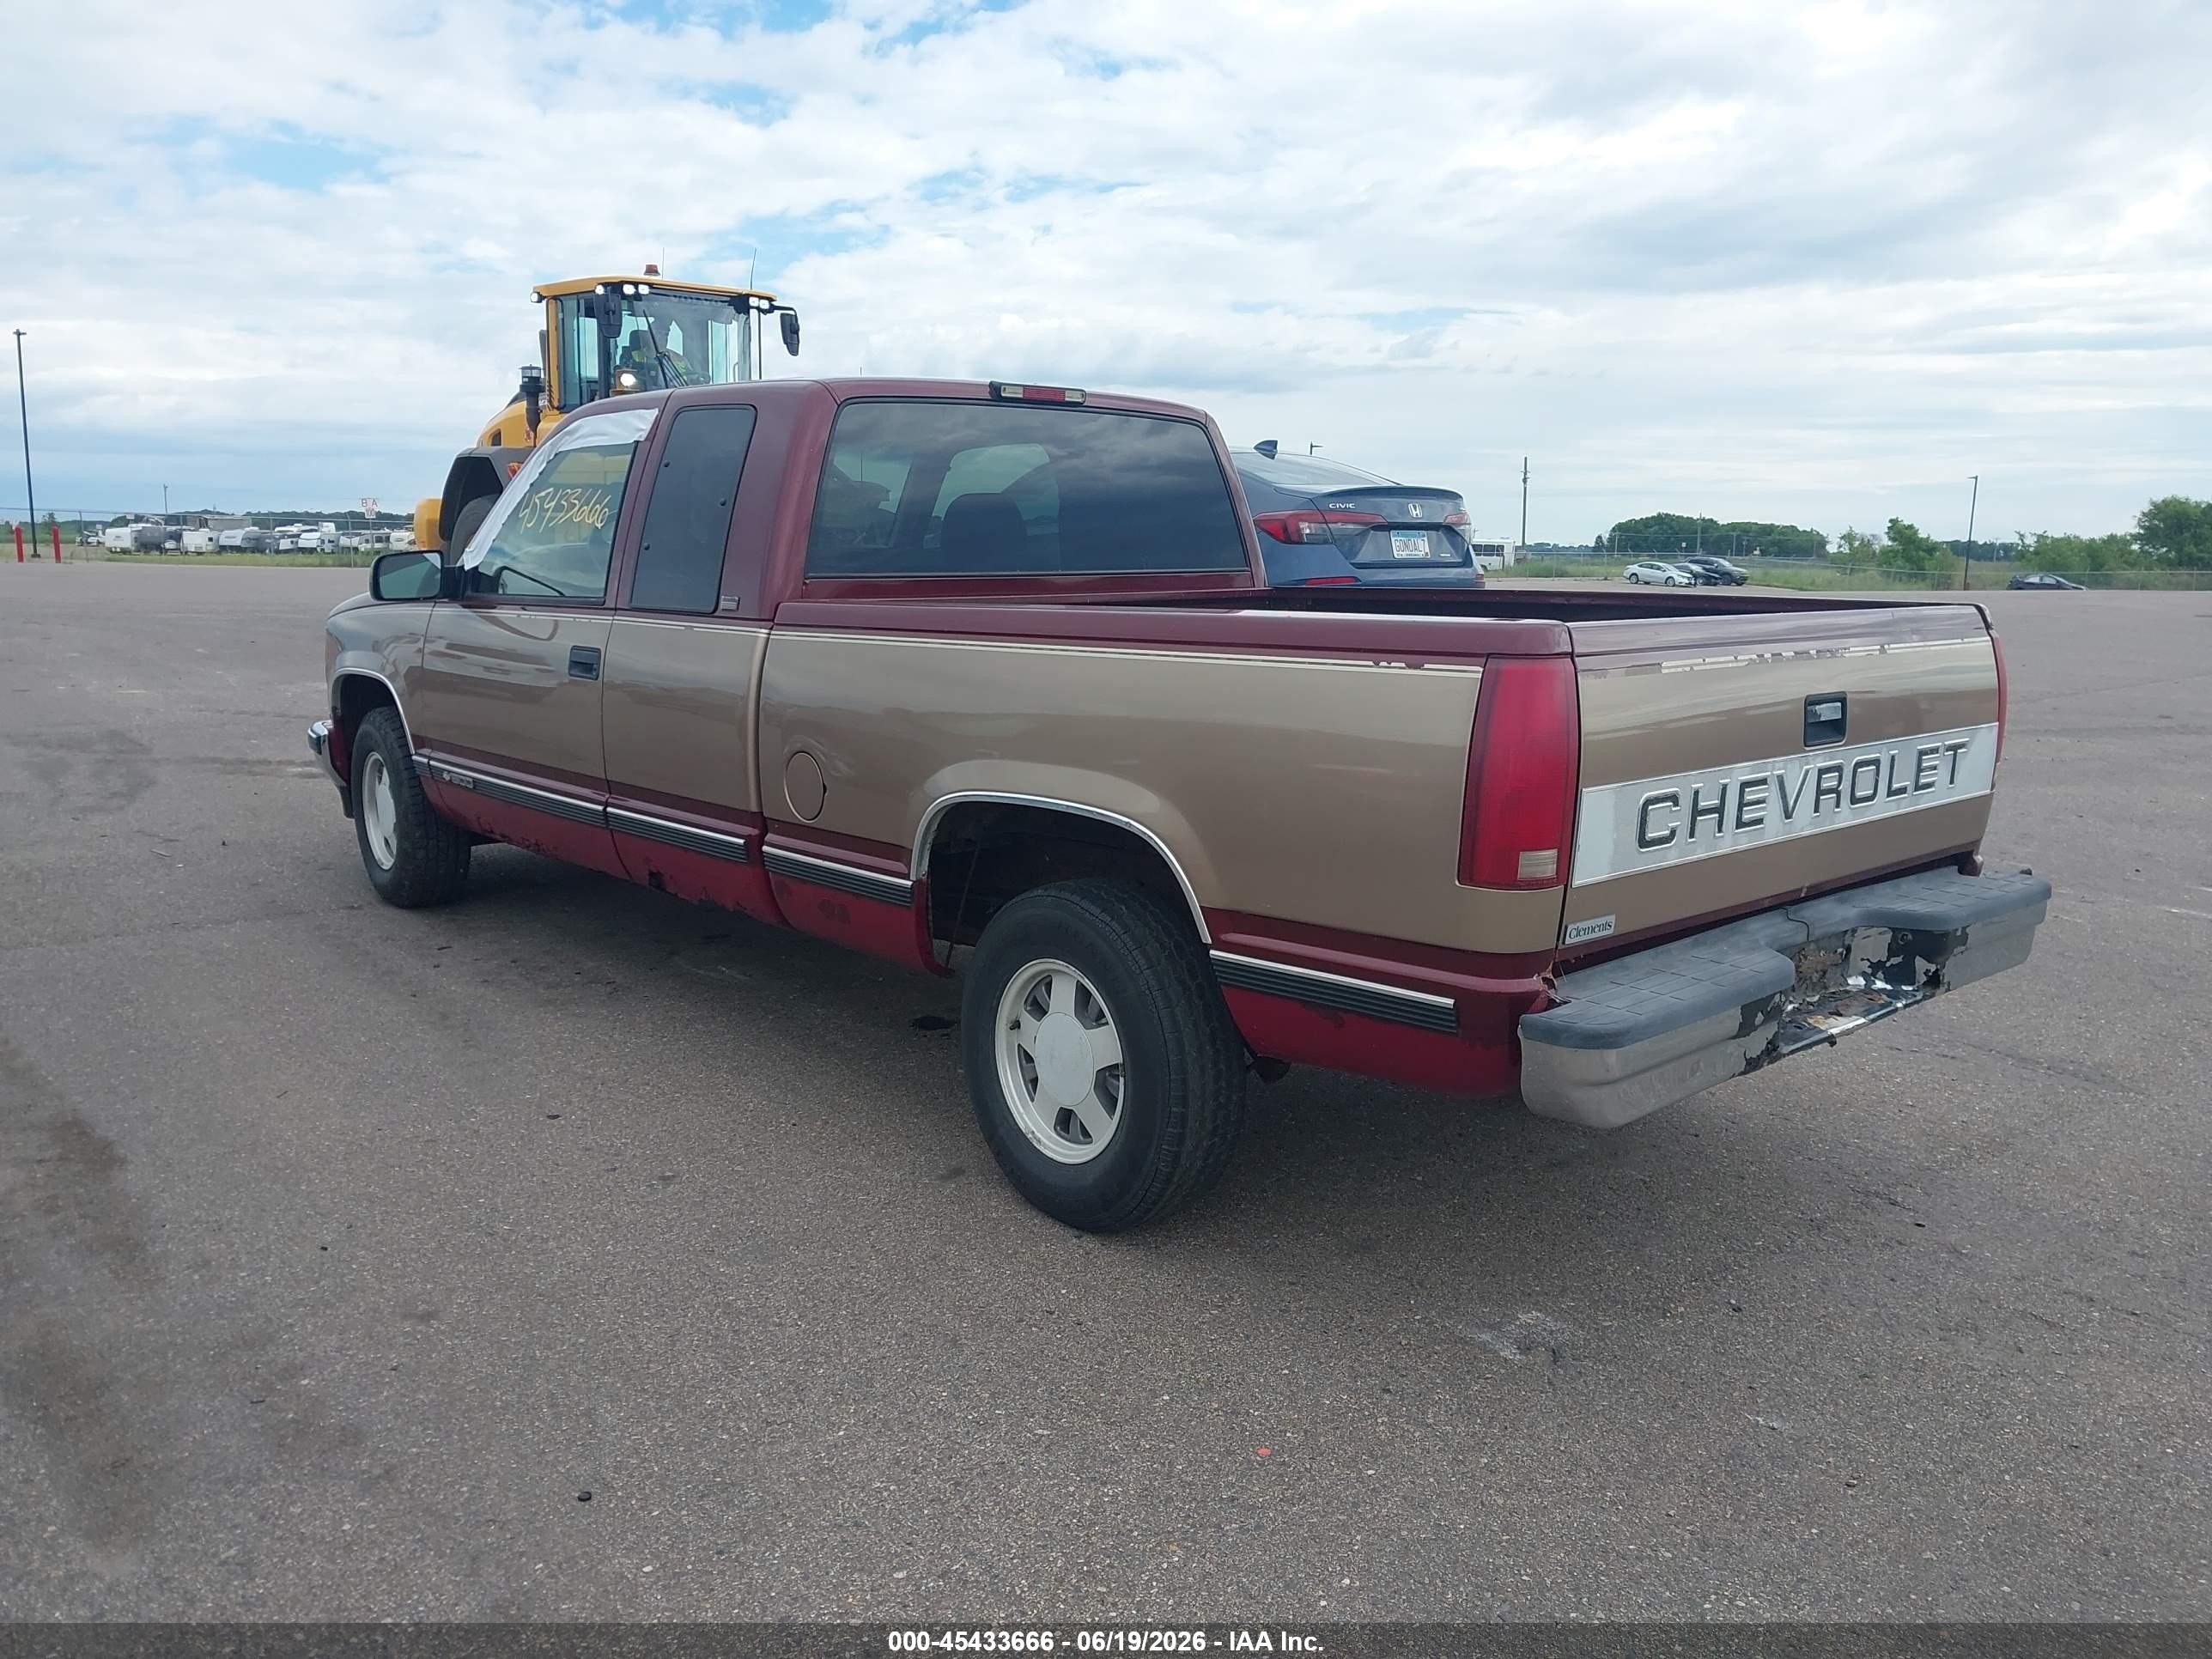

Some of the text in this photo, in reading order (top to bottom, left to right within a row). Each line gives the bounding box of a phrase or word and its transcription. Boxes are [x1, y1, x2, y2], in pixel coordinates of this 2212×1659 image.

[519, 488, 611, 534] 45433666
[1636, 738, 1970, 852] CHEVROLET
[1568, 921, 1613, 939] Clements
